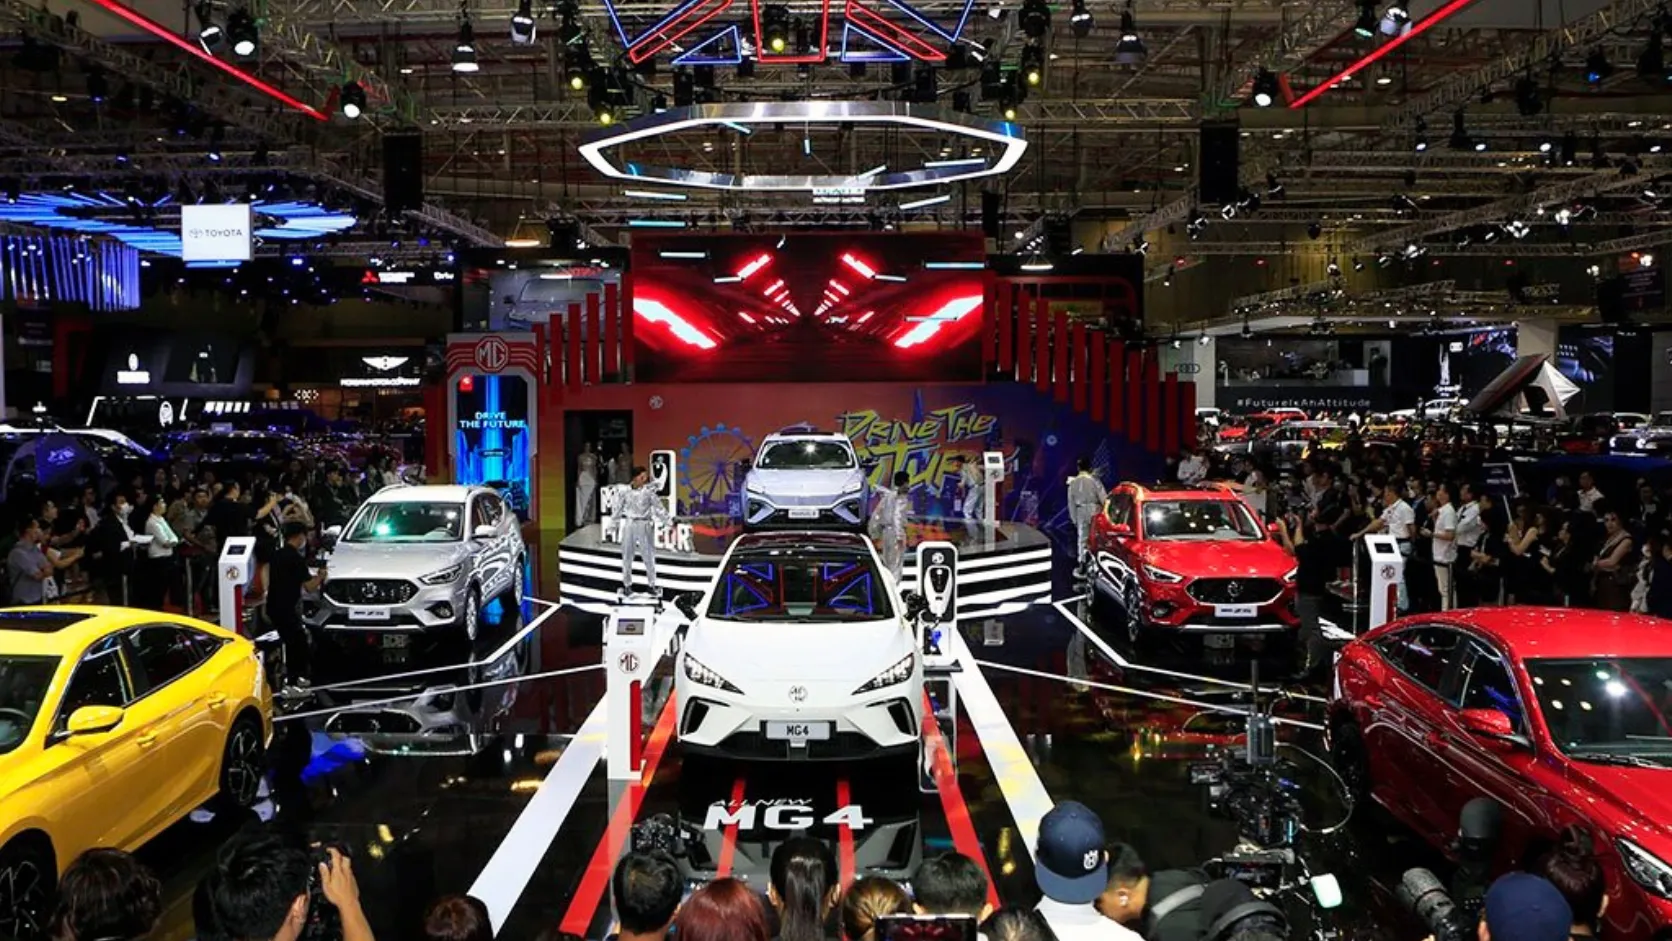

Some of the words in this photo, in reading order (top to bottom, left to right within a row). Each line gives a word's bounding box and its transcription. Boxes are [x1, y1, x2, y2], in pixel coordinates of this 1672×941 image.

[204, 228, 243, 238] TOYOTA
[477, 338, 507, 371] MG
[474, 411, 507, 420] DRIVE
[459, 420, 481, 429] THE
[618, 652, 640, 674] MG
[786, 725, 810, 736] MG4
[703, 805, 874, 830] MG4
